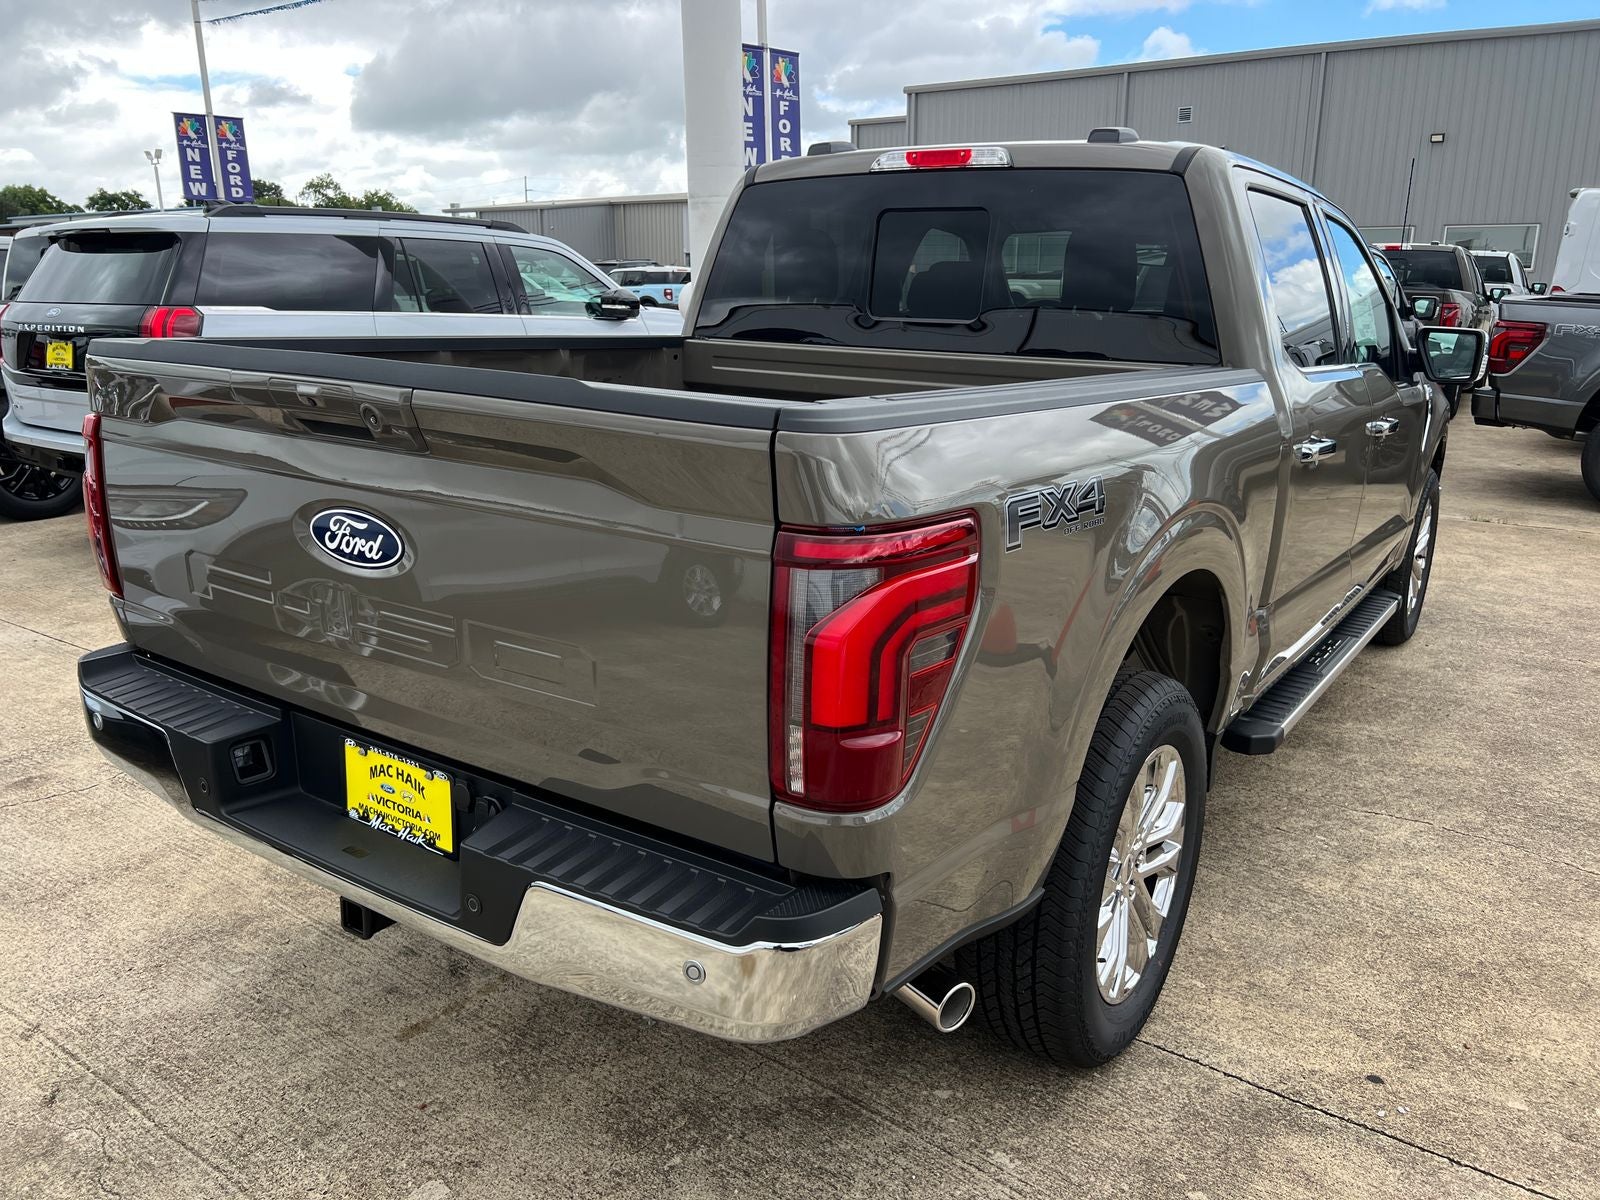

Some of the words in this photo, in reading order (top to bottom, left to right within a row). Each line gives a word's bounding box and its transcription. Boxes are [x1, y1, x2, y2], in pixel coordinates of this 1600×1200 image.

[778, 100, 793, 161] FOR
[185, 147, 207, 196] NEW
[226, 150, 244, 198] FORD
[18, 323, 85, 333] EXPEDITION
[1004, 474, 1106, 553] FX4
[1063, 522, 1083, 536] OFF
[1083, 517, 1105, 531] ROAD
[324, 515, 384, 560] Ford
[370, 764, 393, 780] MAC
[396, 767, 427, 800] HAIK
[358, 802, 441, 841] MACHAIKVICTORIA.COM
[375, 794, 423, 822] VICTORIA
[369, 814, 397, 836] Mac
[397, 827, 428, 846] Haik
